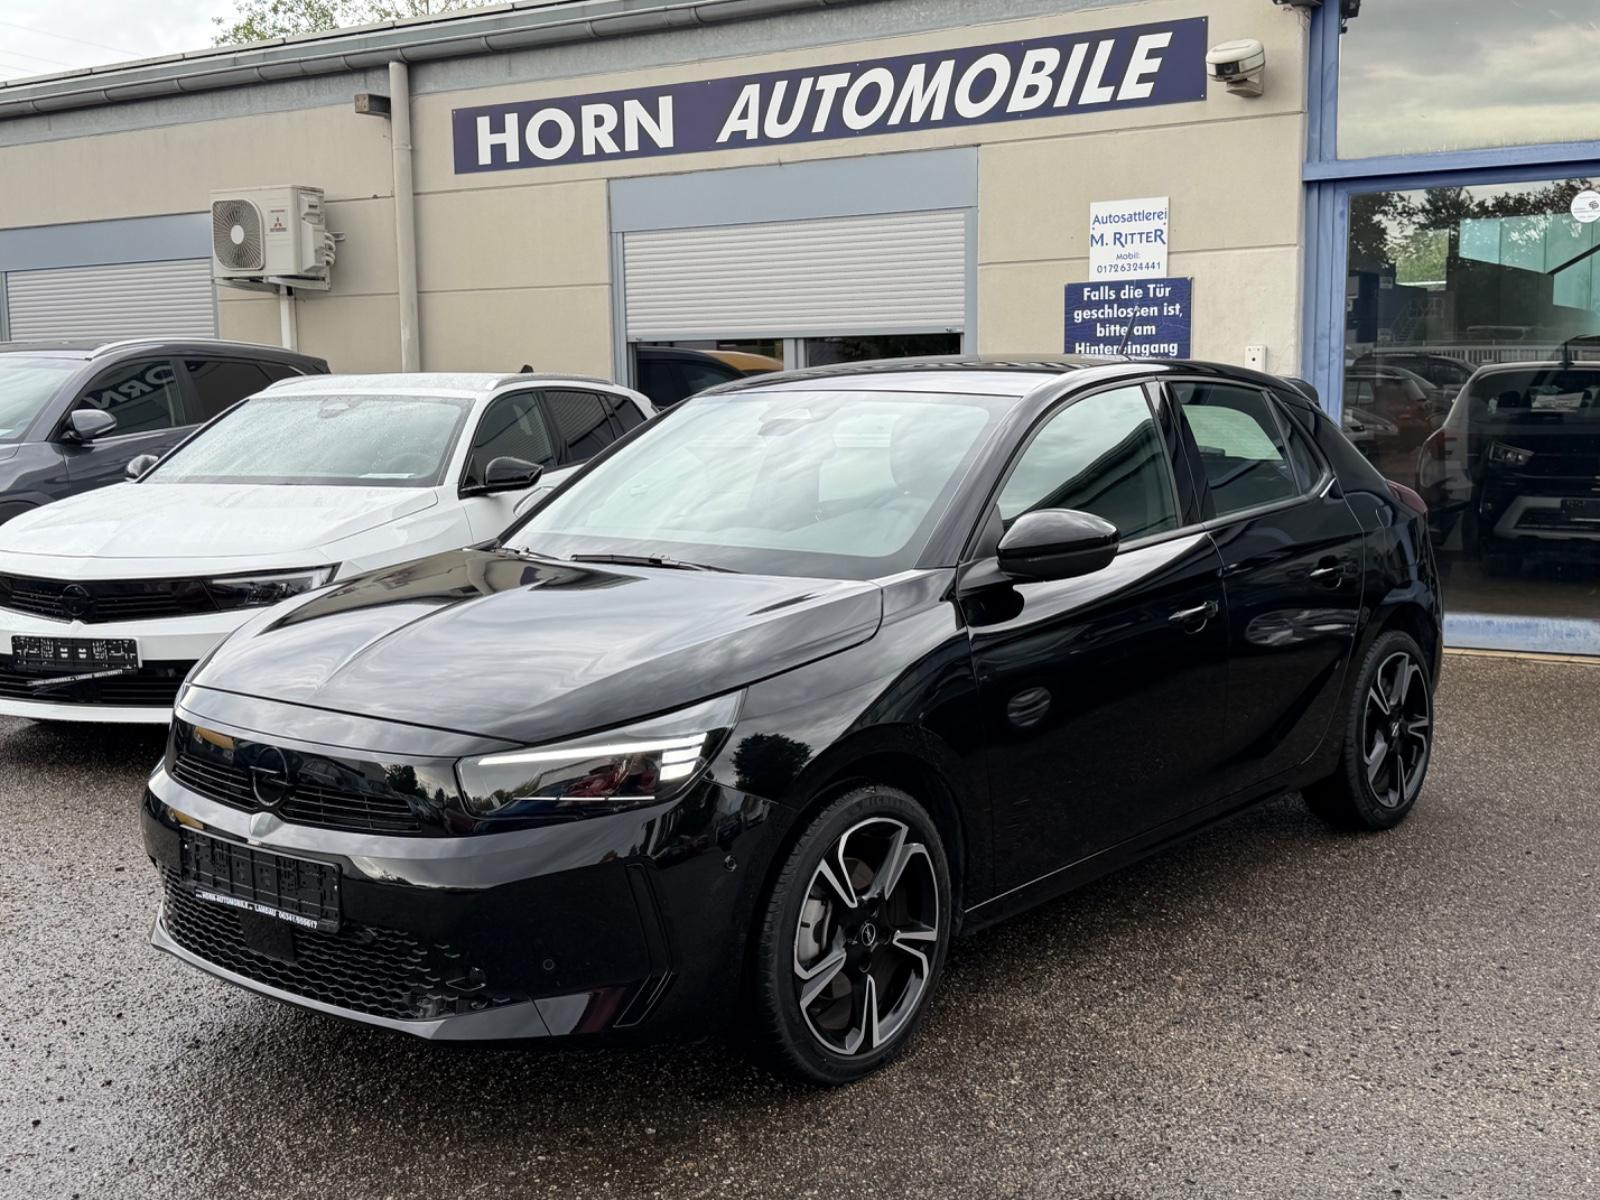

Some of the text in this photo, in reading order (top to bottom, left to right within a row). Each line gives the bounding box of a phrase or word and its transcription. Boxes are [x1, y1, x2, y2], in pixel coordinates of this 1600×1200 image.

[476, 32, 1173, 165] HORN AUTOMOBILE
[1092, 208, 1168, 225] Autosattlerei
[1090, 229, 1166, 248] M. RITTER
[1083, 284, 1171, 301] Falls die Tür
[1163, 302, 1183, 318] ist,
[1096, 323, 1156, 337] bitte am
